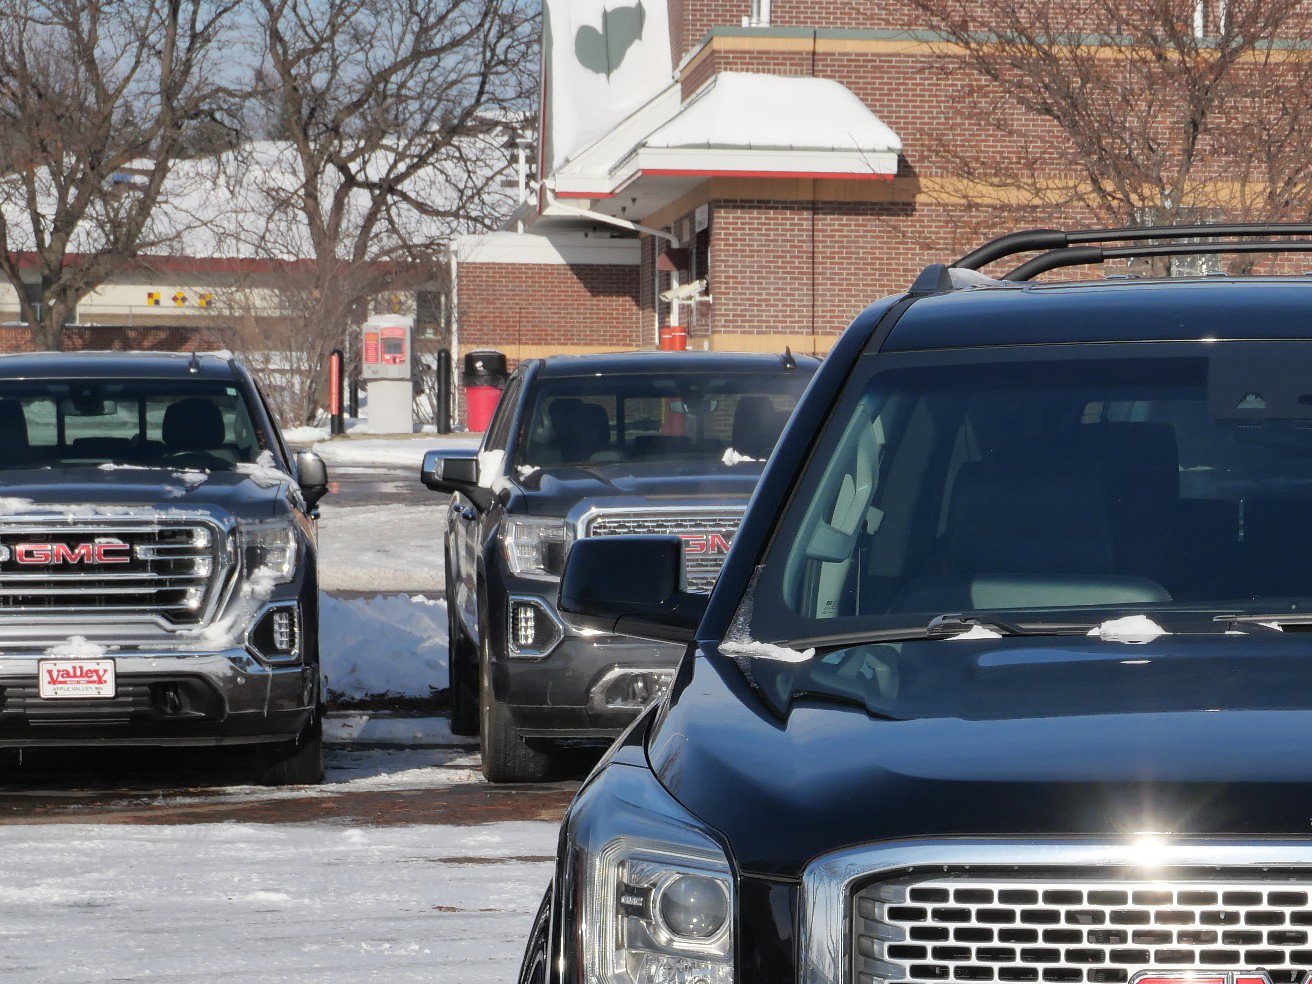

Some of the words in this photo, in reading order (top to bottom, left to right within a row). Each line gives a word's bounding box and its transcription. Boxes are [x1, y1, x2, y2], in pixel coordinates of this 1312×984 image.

[16, 543, 130, 564] GMC
[679, 534, 731, 554] GM
[47, 666, 108, 685] Valley
